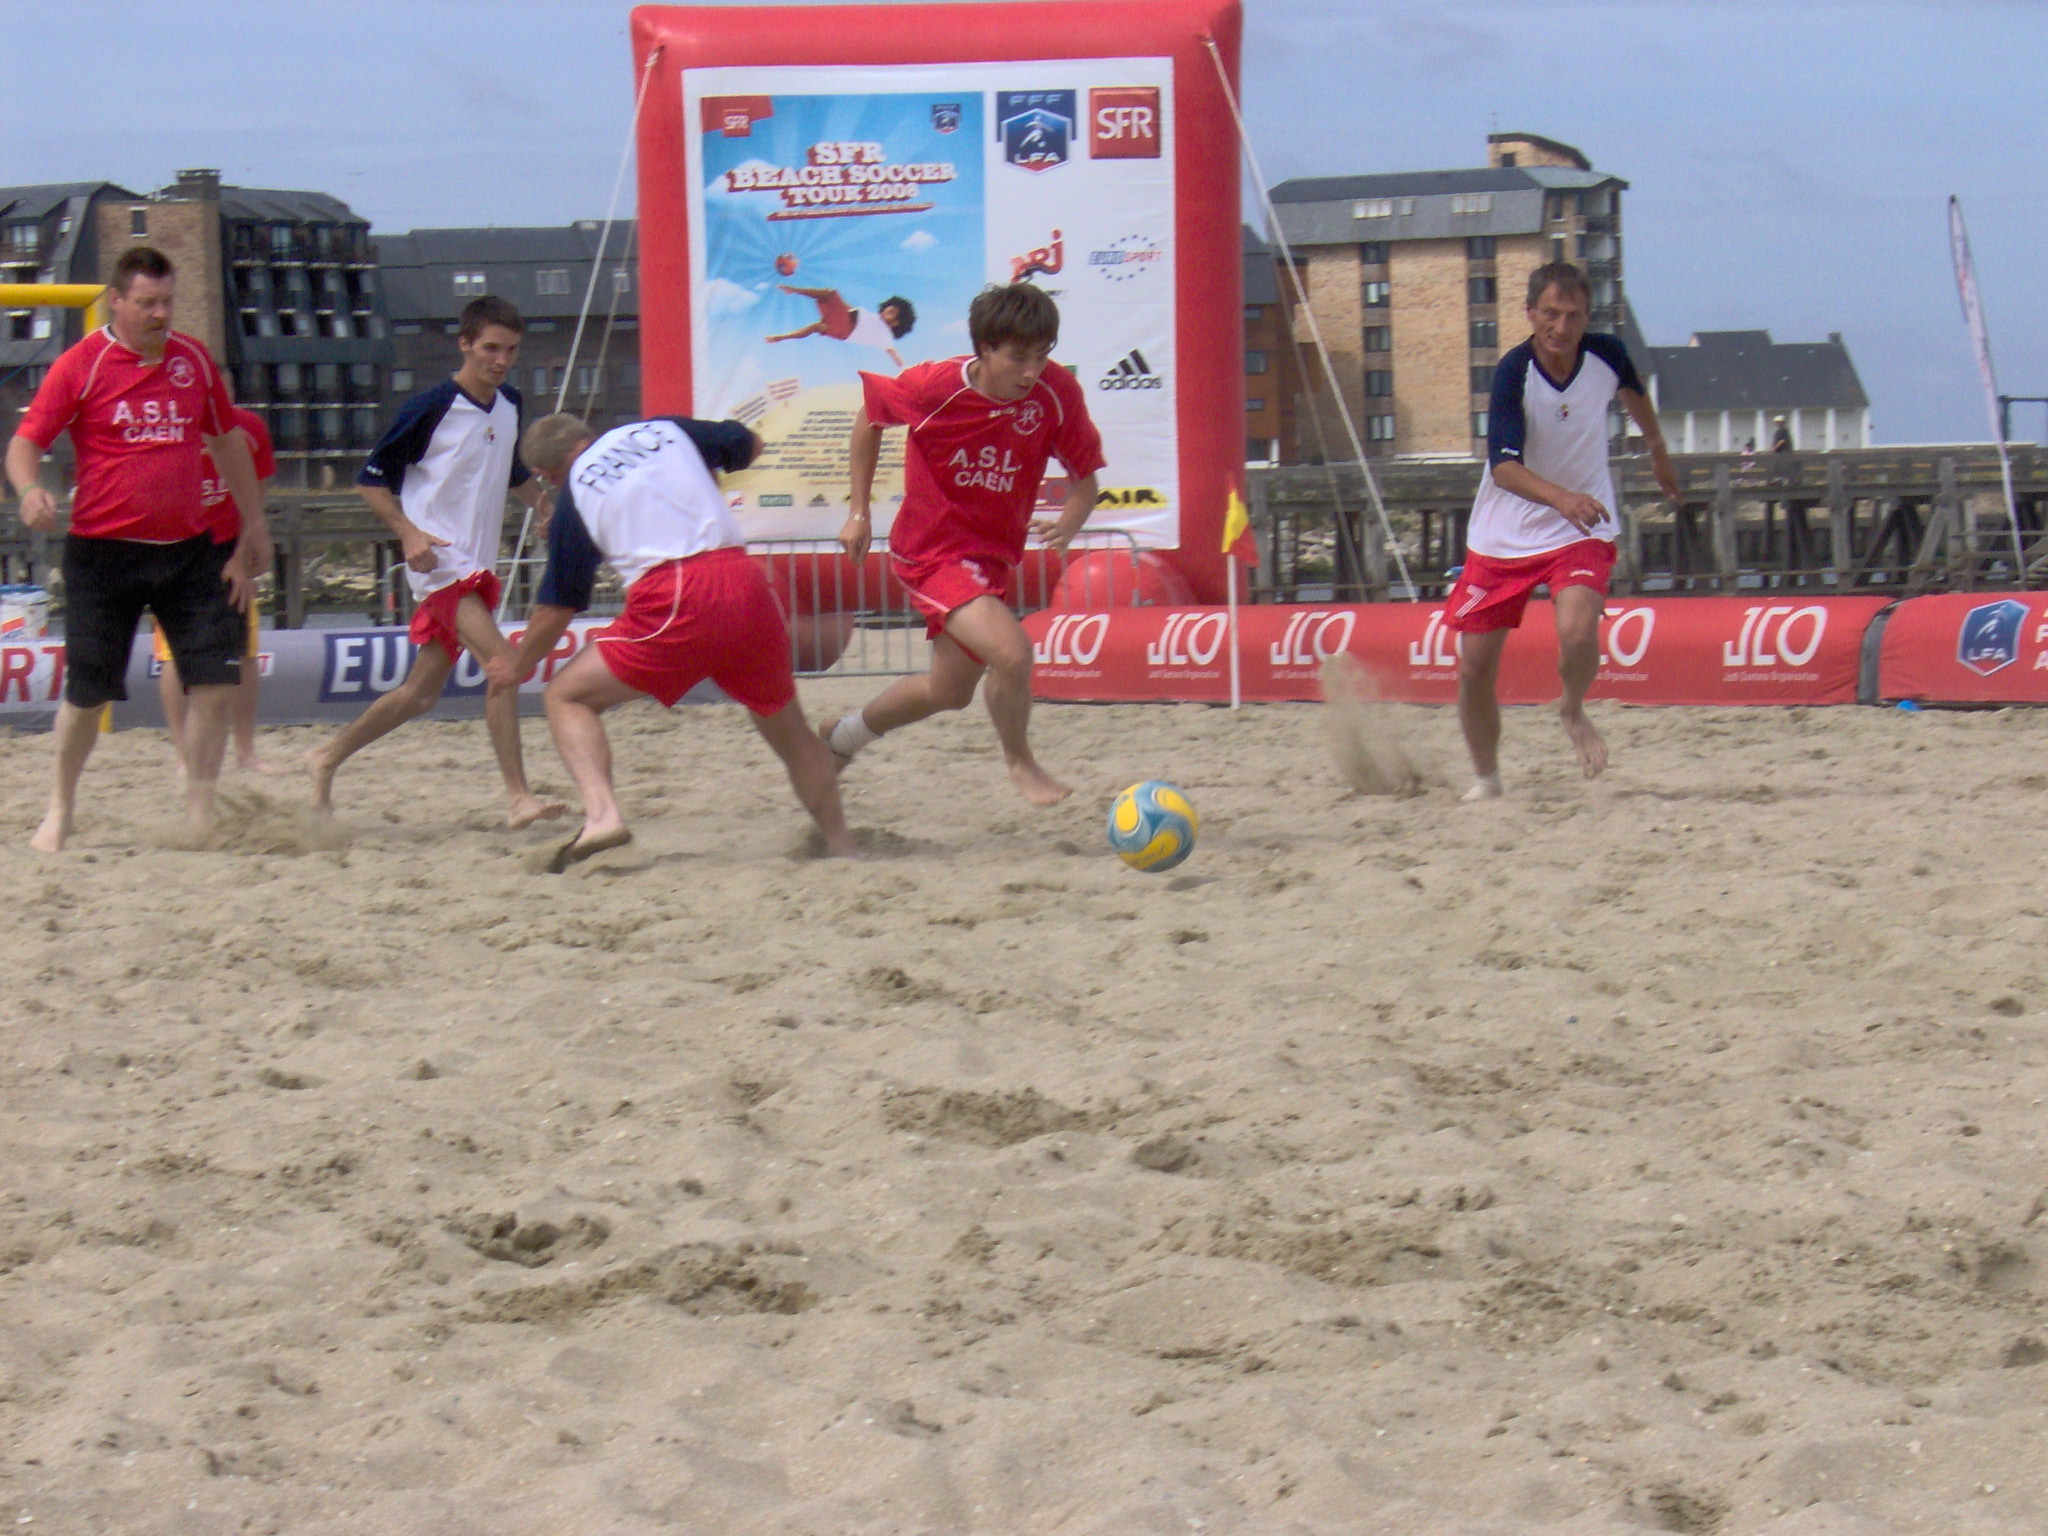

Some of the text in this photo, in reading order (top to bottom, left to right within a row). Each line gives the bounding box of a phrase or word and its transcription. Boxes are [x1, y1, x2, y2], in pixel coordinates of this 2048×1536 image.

[1096, 107, 1154, 139] SFR
[814, 142, 888, 165] SFR
[1013, 152, 1061, 164] LFA
[732, 163, 959, 189] BEACH SOCCER
[786, 187, 862, 206] TOUR
[1099, 373, 1163, 391] adidas
[112, 400, 193, 425] A.S.L.
[122, 426, 184, 442] CAEN
[949, 446, 1022, 474] A.S.L.
[954, 470, 1014, 493] CAEN
[1034, 613, 1110, 665] JCO
[1147, 612, 1228, 665] JCO
[1722, 606, 1828, 667] JCO
[1967, 648, 2008, 660] LFA
